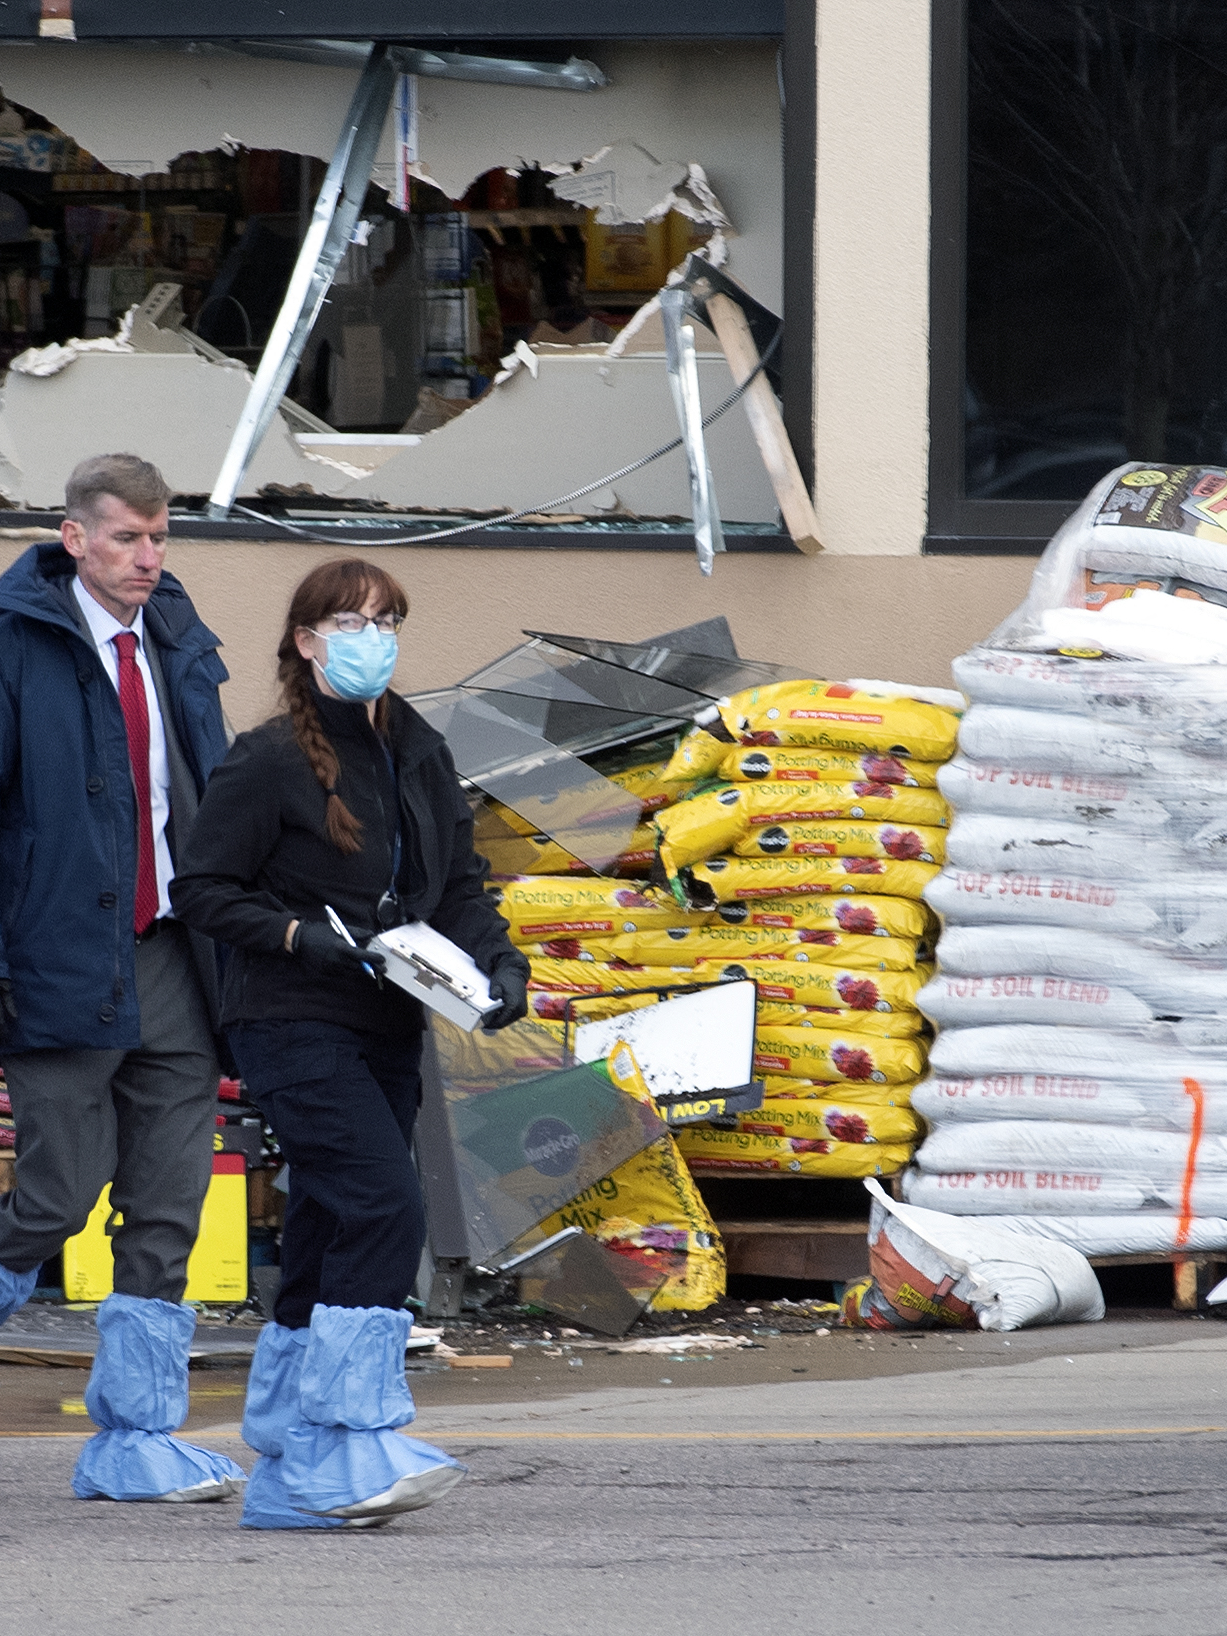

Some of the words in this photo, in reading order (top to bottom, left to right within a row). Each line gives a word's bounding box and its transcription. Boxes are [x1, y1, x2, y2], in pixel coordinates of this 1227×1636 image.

[776, 753, 829, 771] Potting
[831, 755, 857, 770] Mix
[750, 782, 811, 797] Potting
[813, 781, 844, 796] Mix
[792, 826, 847, 844] Potting
[849, 827, 876, 844] Mix
[739, 856, 800, 873] Potting
[803, 856, 832, 871] Mix
[514, 889, 574, 907] Potting
[577, 890, 606, 904] Mix
[955, 873, 992, 893] TOP
[998, 874, 1043, 897] SOIL
[1050, 879, 1118, 907] BLEND
[751, 900, 804, 918] Potting
[807, 902, 832, 918] Mix
[699, 926, 758, 944] Potting
[760, 928, 790, 944] Mix
[754, 966, 806, 988] Potting
[808, 972, 834, 989] Mix
[946, 977, 984, 998] TOP
[990, 976, 1036, 998] SOIL
[1042, 979, 1111, 1005] BLEND
[803, 1043, 829, 1059] Mix
[938, 1077, 975, 1098] TOP
[981, 1075, 1027, 1098] SOIL
[1033, 1075, 1101, 1099] BLEND
[673, 1098, 726, 1118] LOW
[795, 1110, 822, 1127] Mix
[690, 1129, 750, 1149] Potting
[752, 1131, 782, 1149] Mix
[937, 1171, 976, 1189] TOP
[982, 1170, 1028, 1190] SOIL
[1035, 1172, 1102, 1191] BLEND
[528, 1173, 619, 1217] Potting
[559, 1206, 608, 1231] Mix
